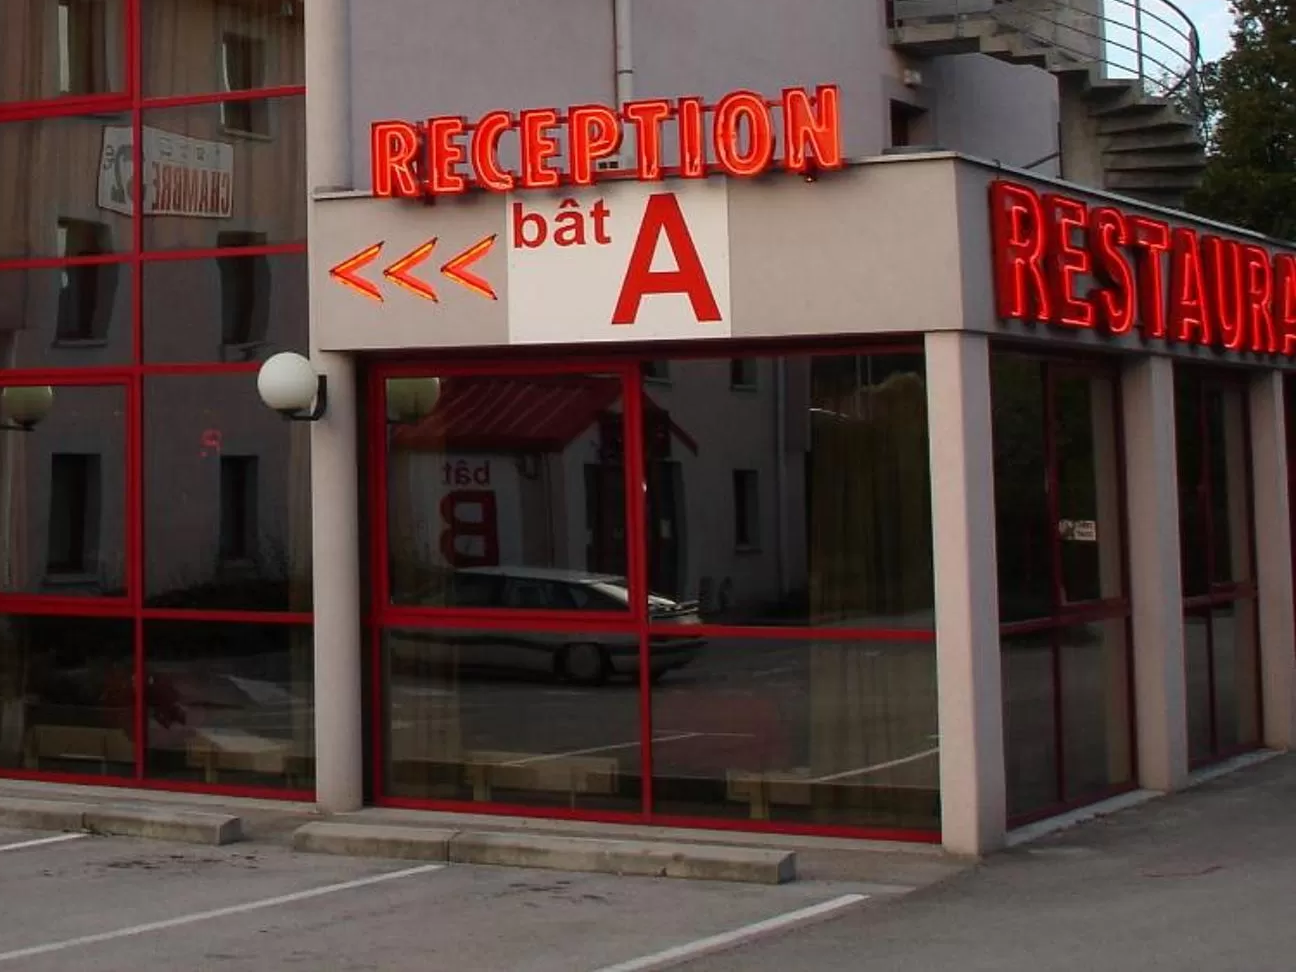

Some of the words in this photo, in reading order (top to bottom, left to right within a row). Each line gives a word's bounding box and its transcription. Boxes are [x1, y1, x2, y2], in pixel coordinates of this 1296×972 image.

[370, 84, 842, 198] RECEPTION
[512, 199, 612, 249] bât
[611, 193, 722, 325] A
